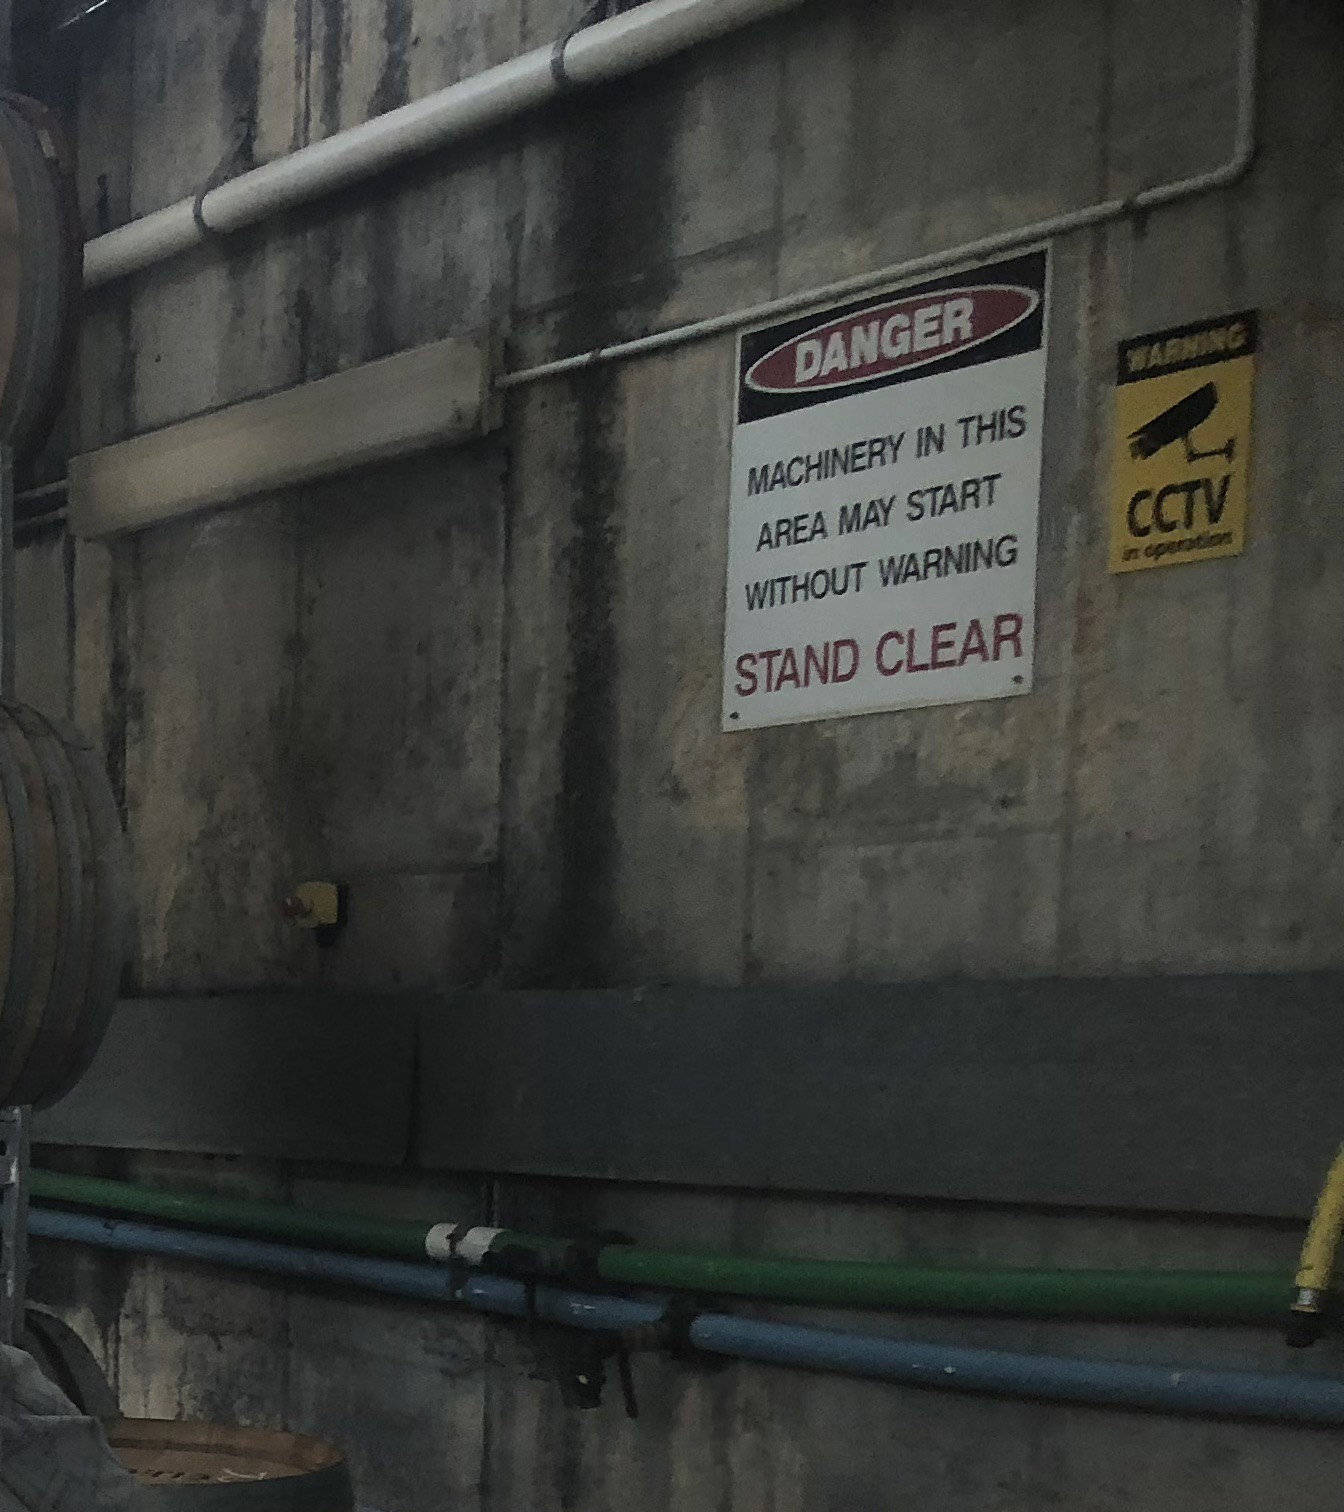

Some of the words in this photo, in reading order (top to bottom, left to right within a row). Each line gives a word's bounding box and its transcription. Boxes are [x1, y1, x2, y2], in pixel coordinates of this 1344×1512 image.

[794, 297, 975, 384] DANGER
[747, 430, 905, 497] MACHINERY
[915, 422, 945, 459] IN
[957, 404, 1027, 450] THIS
[756, 511, 829, 552] AREA
[838, 494, 897, 536] MAY
[906, 473, 1002, 522] START
[1126, 471, 1234, 538] CCTV
[745, 560, 869, 612] WITHOUT
[878, 533, 1019, 588] WARNING
[734, 638, 860, 698] STAND
[875, 612, 1025, 678] CLEAR
